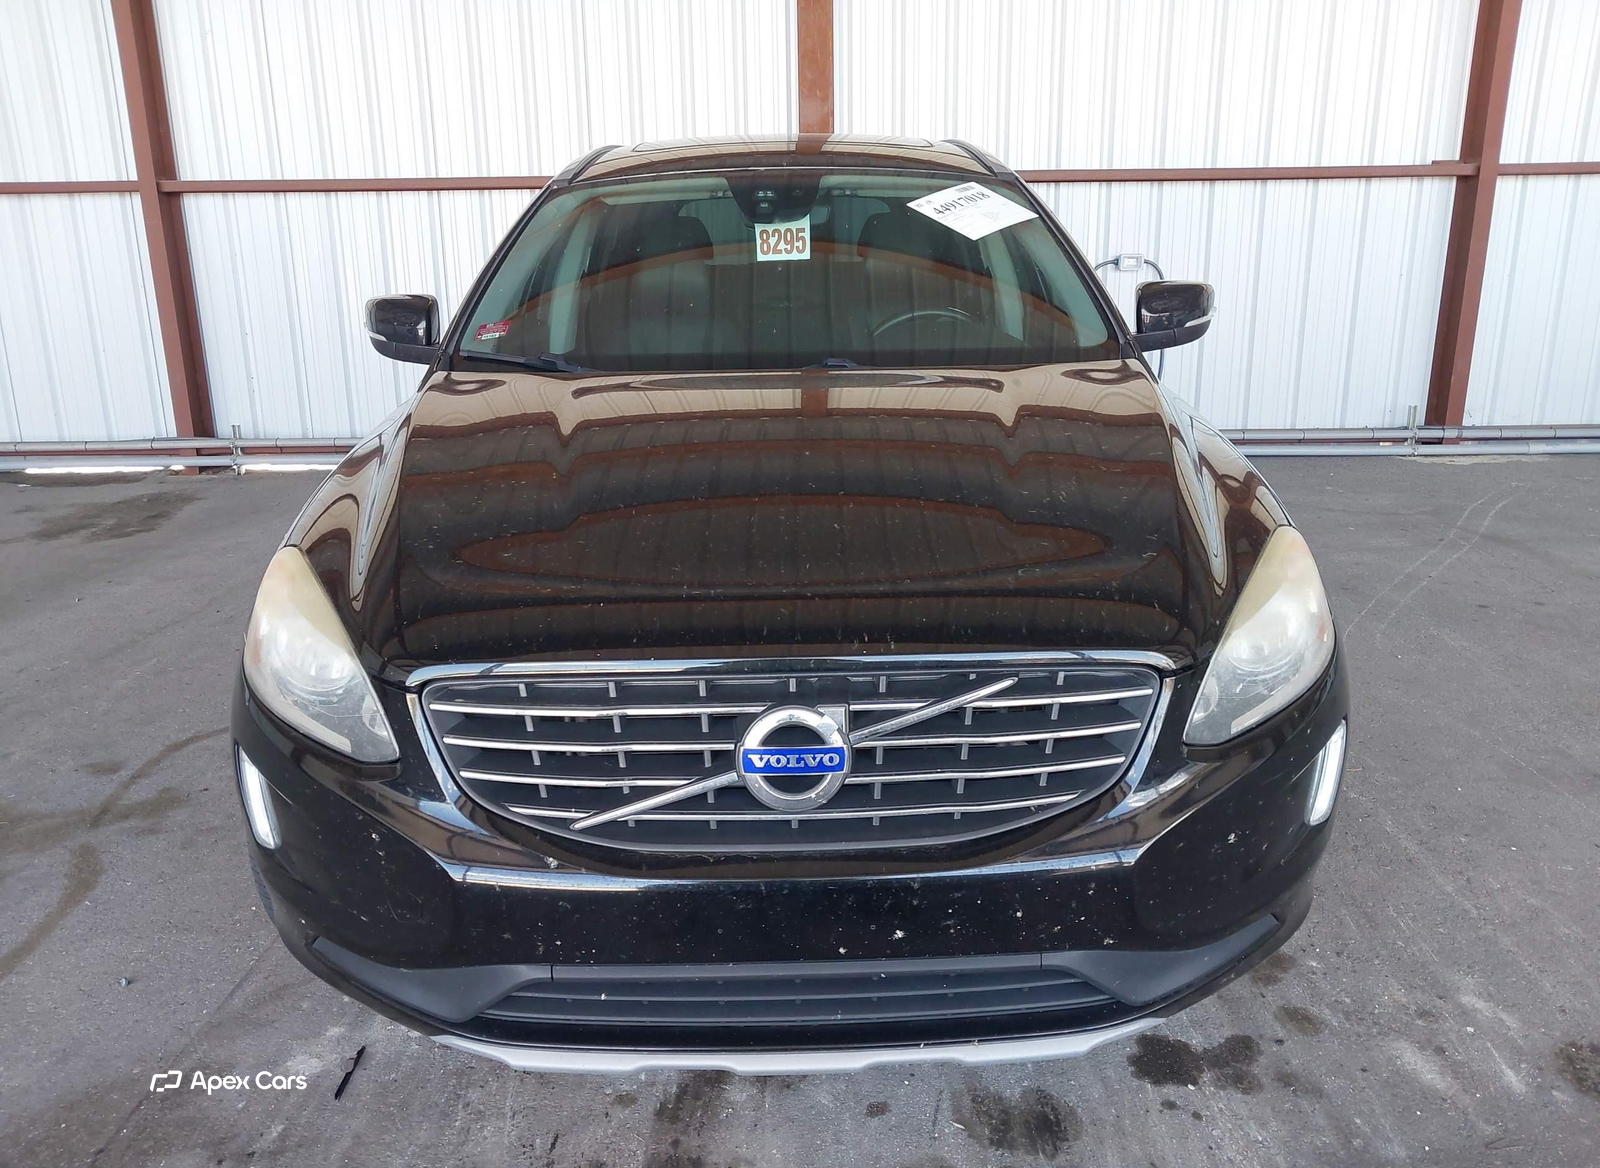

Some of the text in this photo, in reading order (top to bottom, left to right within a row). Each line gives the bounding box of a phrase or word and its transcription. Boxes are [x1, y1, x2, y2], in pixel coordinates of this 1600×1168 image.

[933, 191, 991, 215] 44917018
[759, 228, 807, 255] 8295
[747, 753, 840, 768] VOLVO
